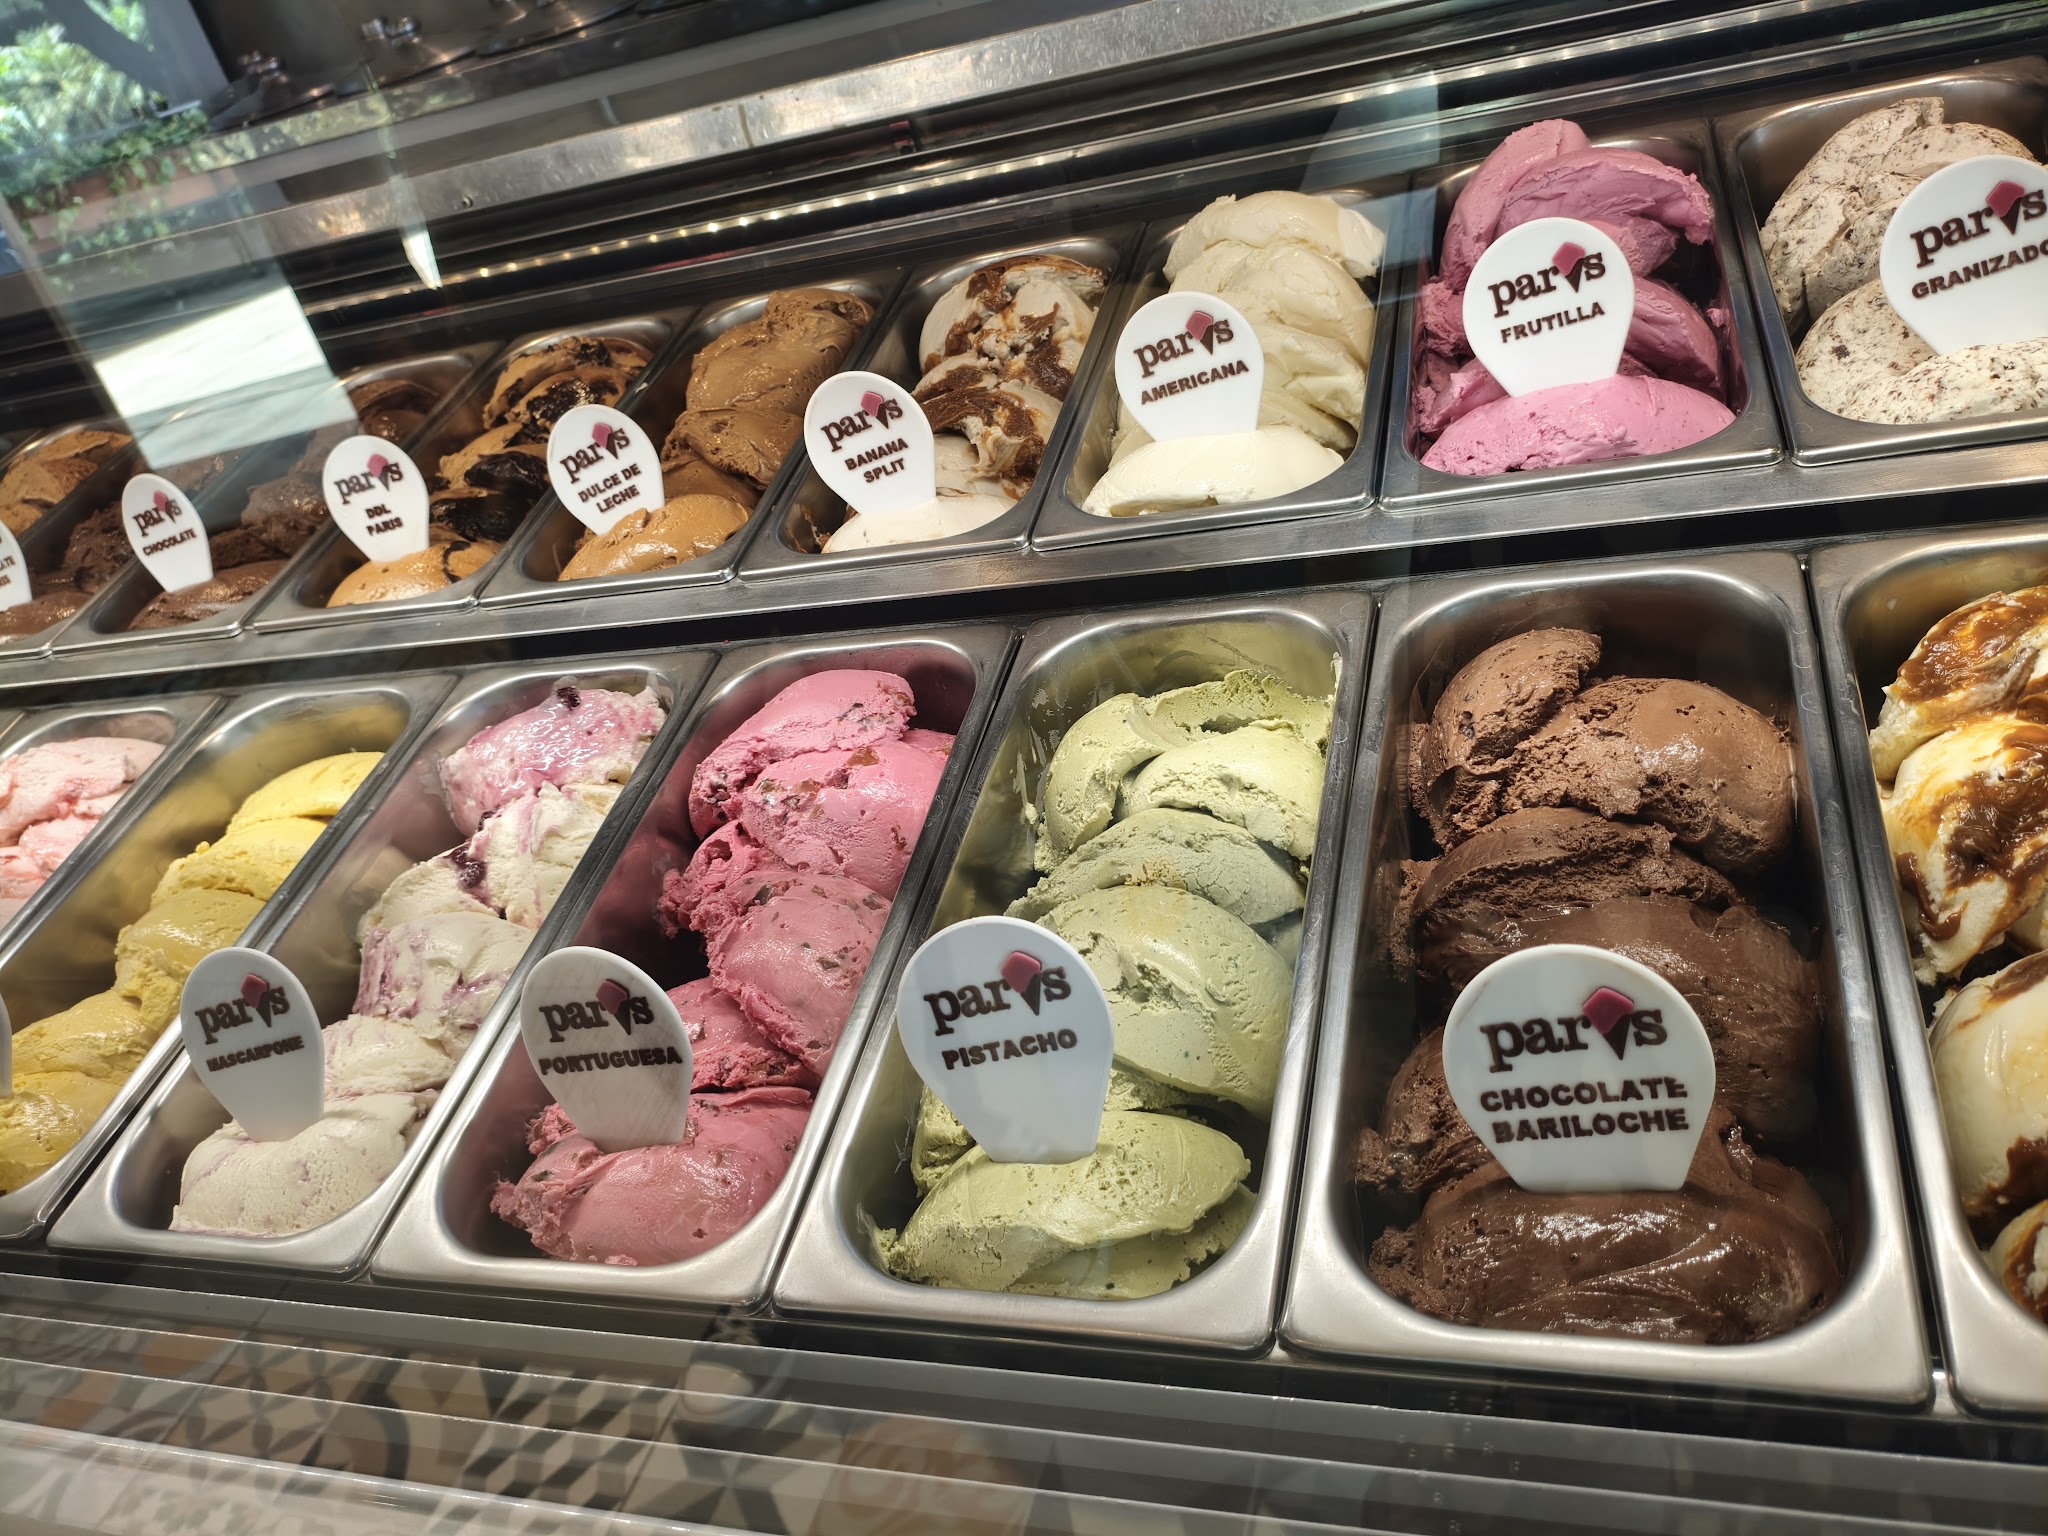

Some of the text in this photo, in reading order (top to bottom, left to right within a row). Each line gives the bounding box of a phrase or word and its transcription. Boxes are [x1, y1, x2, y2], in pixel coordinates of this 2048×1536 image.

[1500, 302, 1605, 344] FRUTILLA
[1141, 360, 1249, 405] AMERICANA
[844, 437, 909, 471] BANANA
[863, 458, 905, 483] SPLIT
[577, 463, 642, 503] DULCE DE
[596, 484, 640, 513] LECHE
[142, 528, 197, 556] CHOCOLATE
[366, 517, 404, 536] PARIS
[206, 1035, 305, 1072] MASCARPONE
[538, 1046, 683, 1076] PORTUGUESA
[942, 1028, 1078, 1070] PISTACHO
[1480, 1077, 1688, 1112] CHOCOLATE
[1492, 1108, 1689, 1143] BARILOCHE
